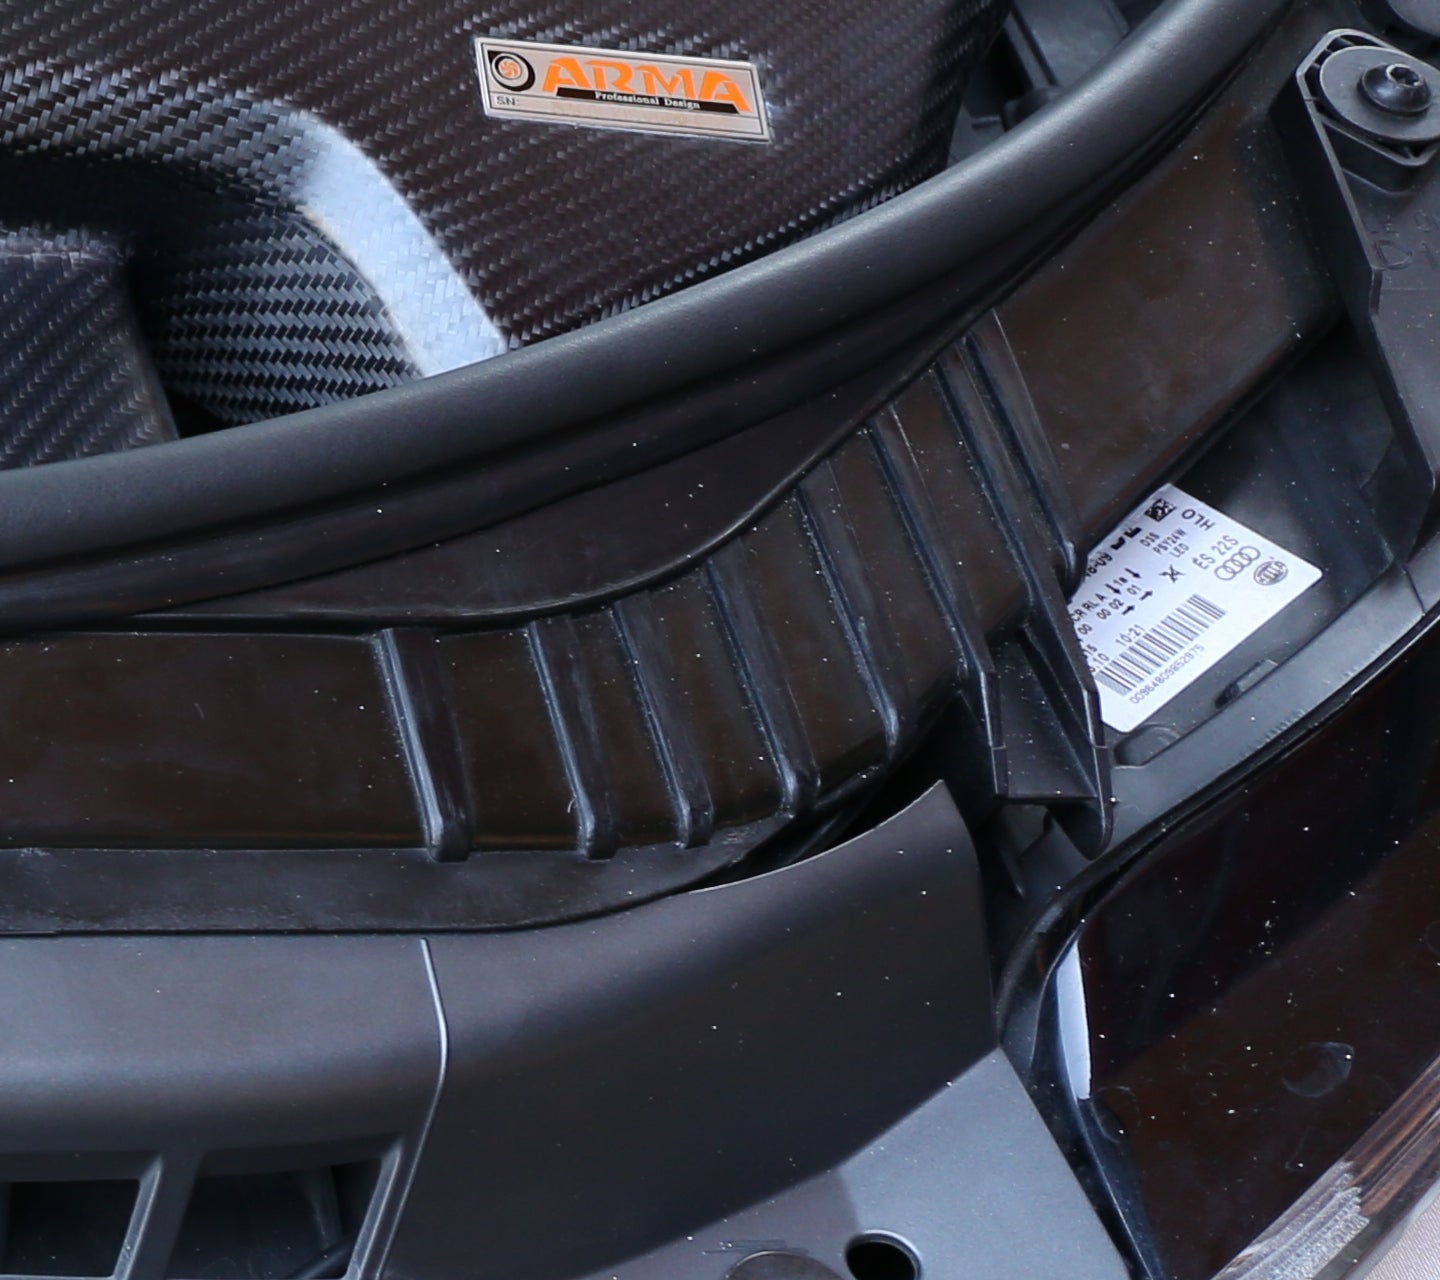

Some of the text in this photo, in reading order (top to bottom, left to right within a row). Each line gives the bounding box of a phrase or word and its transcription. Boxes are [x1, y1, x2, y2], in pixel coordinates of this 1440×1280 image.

[542, 56, 753, 112] ARMA
[595, 90, 700, 110] Professional Design
[1182, 507, 1216, 531] HLO
[1154, 529, 1185, 554] PSY24W
[1211, 534, 1238, 555] 22S
[1115, 624, 1144, 647] 10:21
